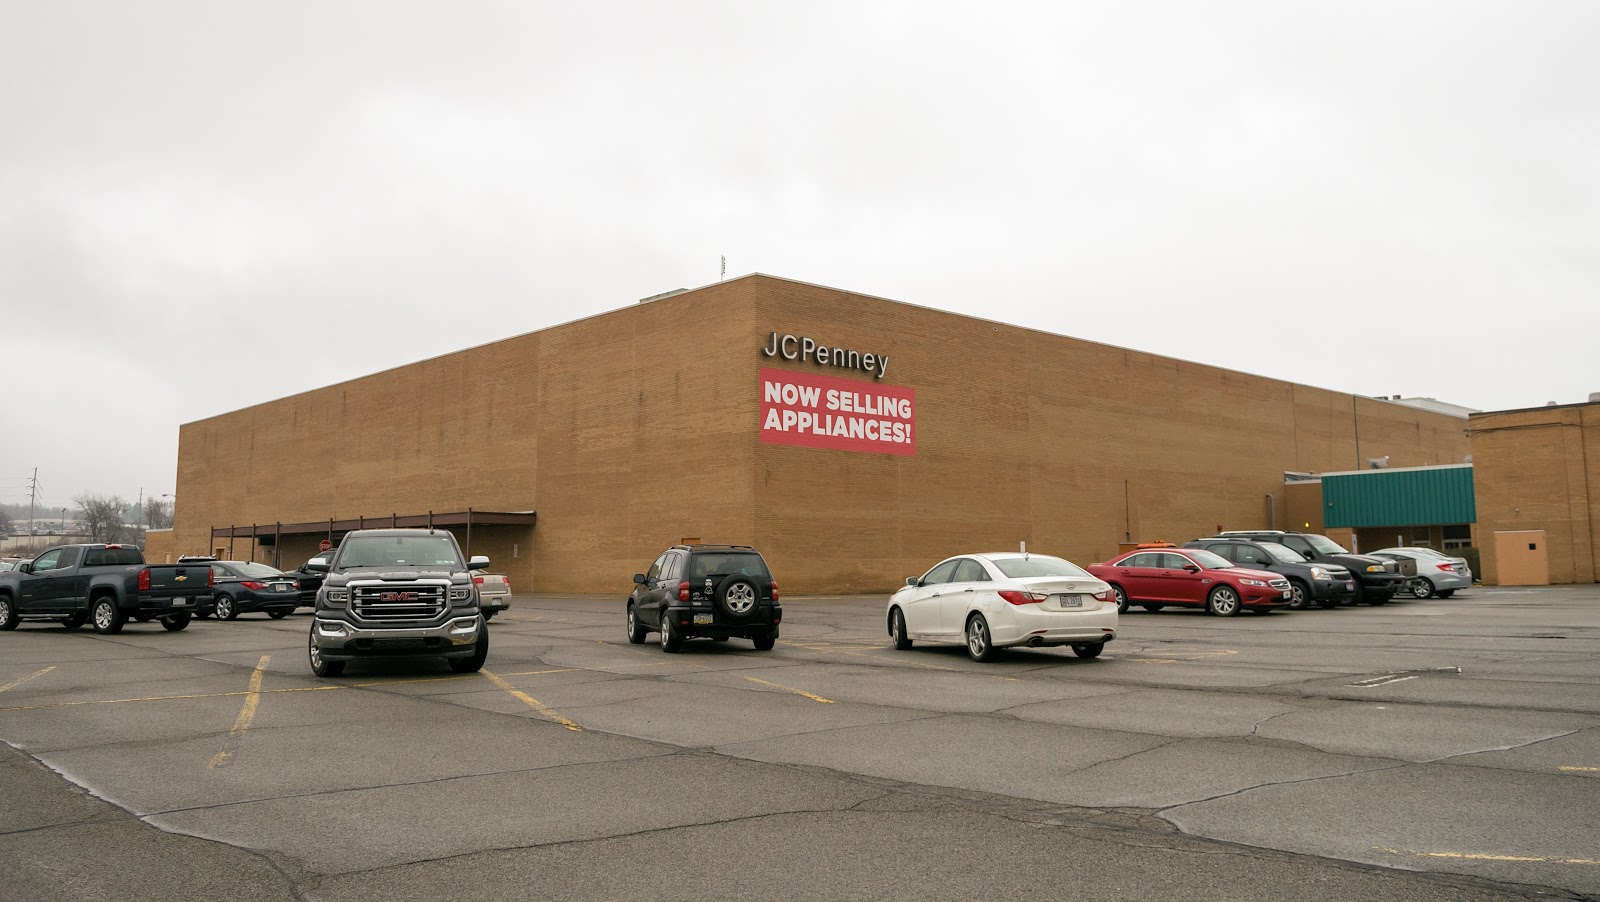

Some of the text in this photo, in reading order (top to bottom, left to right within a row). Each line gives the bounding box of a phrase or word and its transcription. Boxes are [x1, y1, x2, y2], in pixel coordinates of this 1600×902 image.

[763, 332, 889, 379] JCPenney
[764, 381, 912, 419] NOW SELLING
[763, 408, 911, 444] APPLIANCES!
[381, 592, 418, 601] GMC
